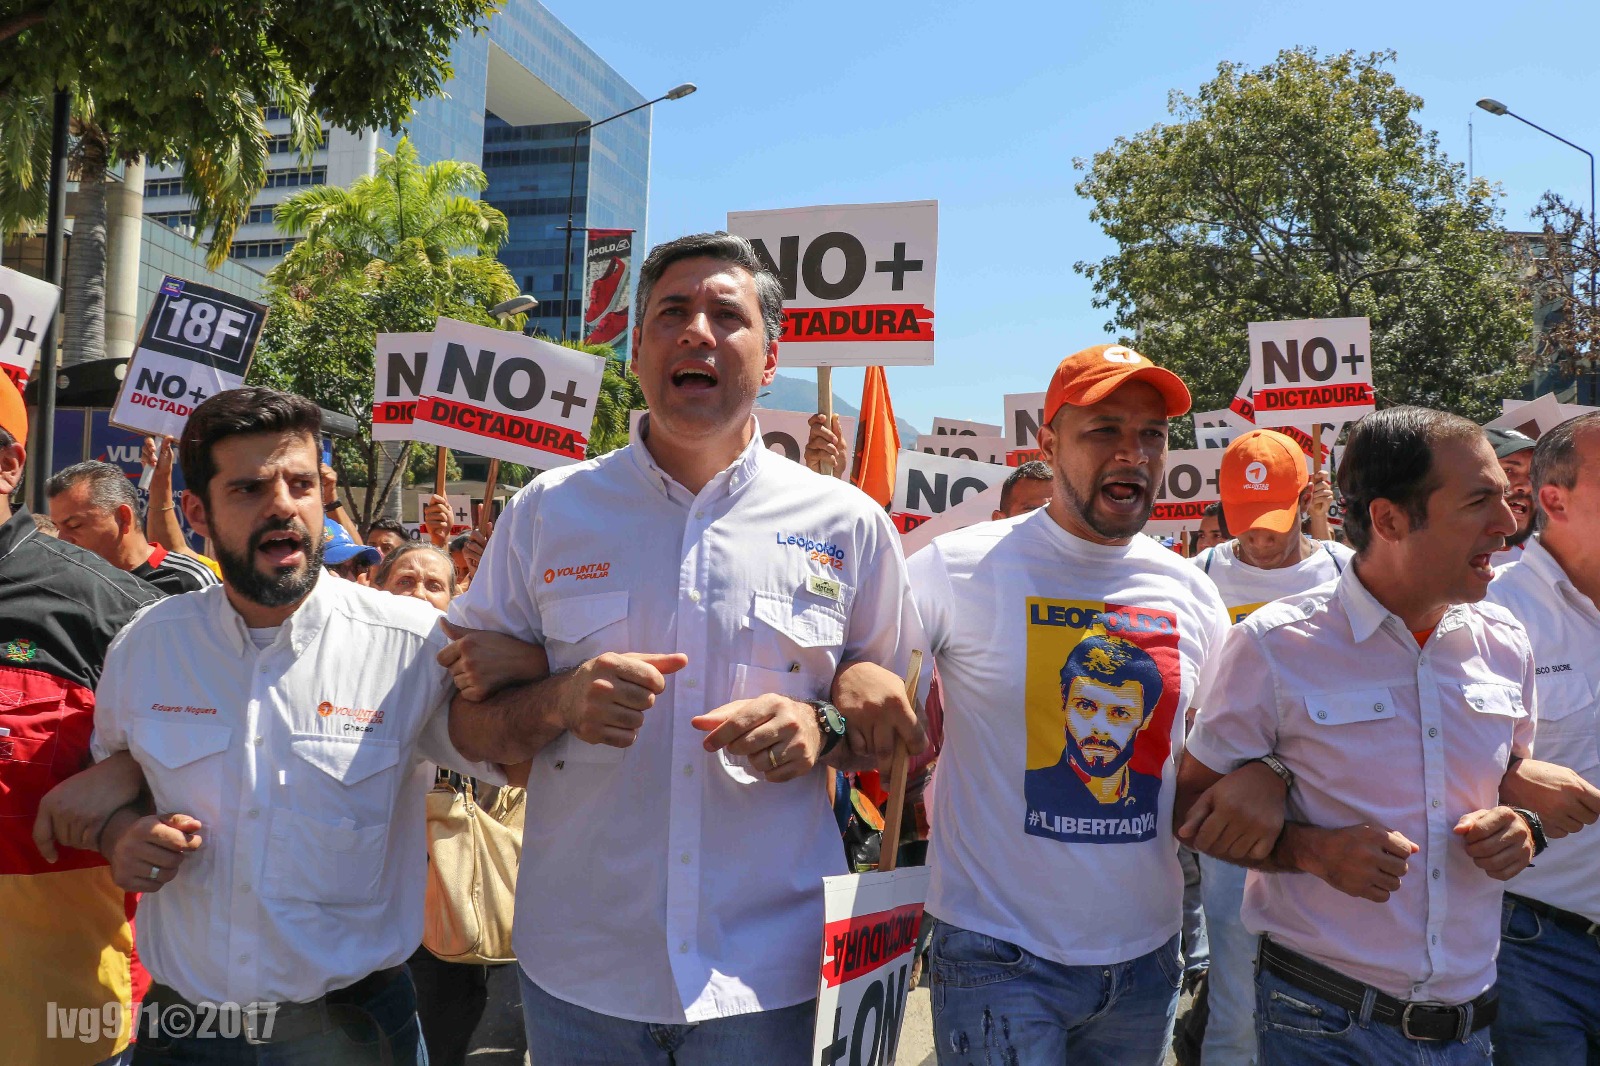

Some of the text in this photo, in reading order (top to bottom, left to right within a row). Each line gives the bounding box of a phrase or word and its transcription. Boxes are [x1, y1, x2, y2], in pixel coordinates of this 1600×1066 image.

[587, 244, 616, 257] APOLO
[167, 298, 247, 350] 18F
[782, 309, 921, 337] TADURA
[130, 392, 193, 417] DICTAD
[1265, 386, 1369, 408] DICTADURA
[430, 404, 577, 453] DICTADURA
[906, 468, 989, 514] NO
[1151, 503, 1206, 518] CTADU
[776, 531, 844, 560] Leopoldo
[557, 562, 611, 577] VOLUNTAD
[811, 551, 844, 570] 2012
[576, 571, 609, 581] POPULAR
[1030, 604, 1174, 635] LEOPOLDO
[151, 703, 217, 715] Eduardo Noguera
[334, 706, 385, 719] VOLUNTAD
[833, 910, 917, 978] DICTADURA
